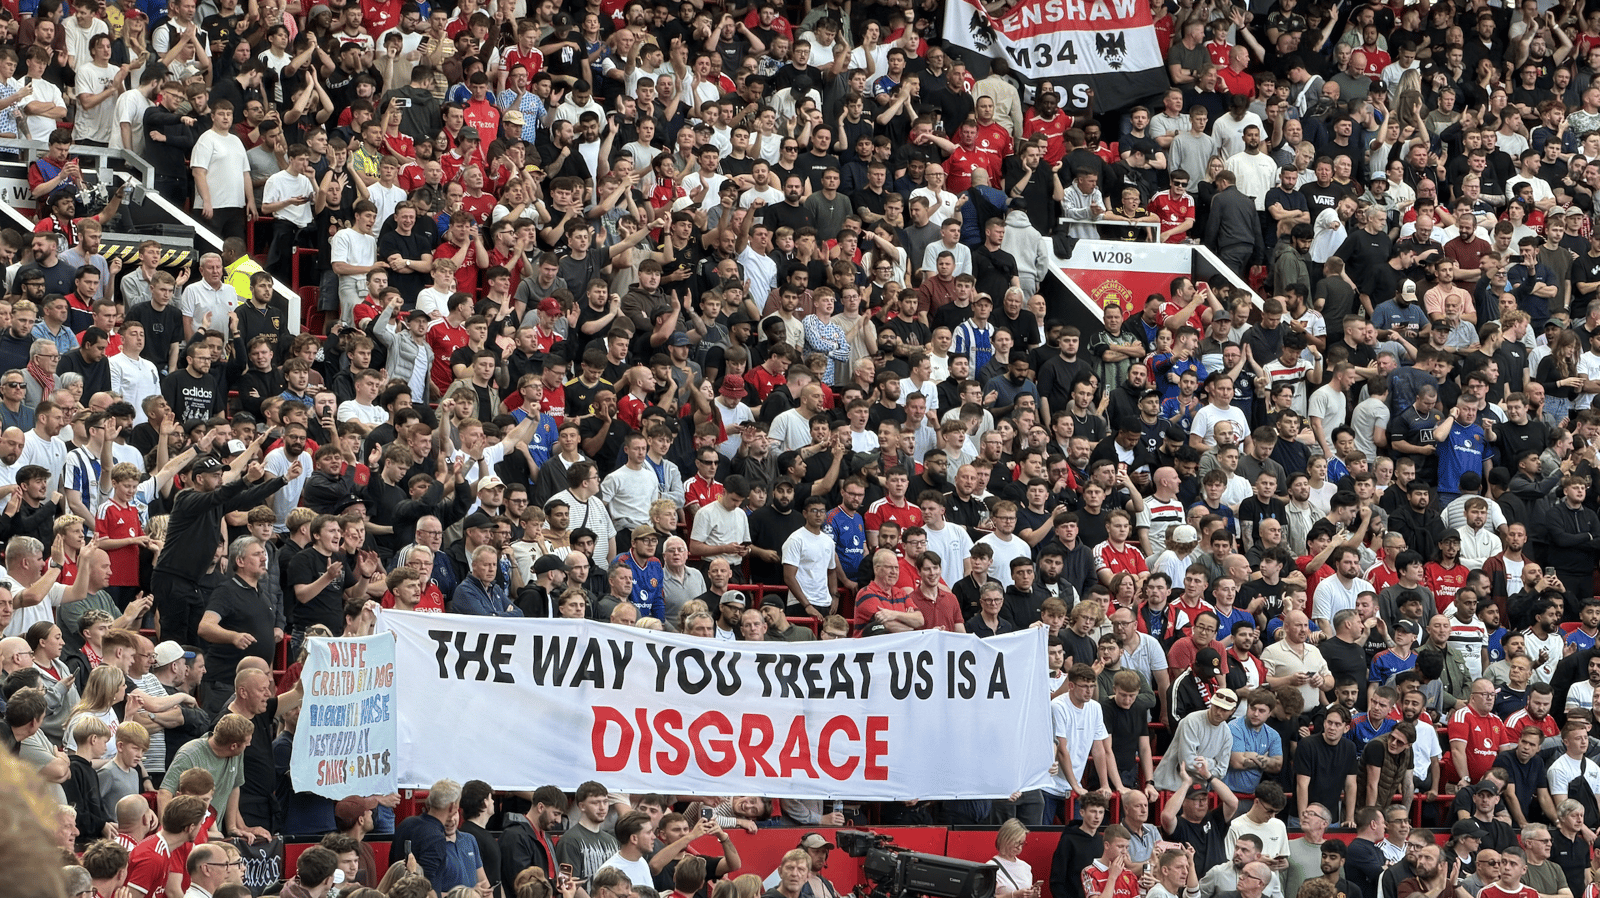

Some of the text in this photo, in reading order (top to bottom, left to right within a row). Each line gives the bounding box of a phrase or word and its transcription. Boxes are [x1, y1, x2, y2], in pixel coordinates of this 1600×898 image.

[1006, 40, 1078, 69] M34
[1313, 195, 1335, 206] VANS
[1092, 251, 1133, 265] W208
[1094, 282, 1130, 300] MANCHESTER
[182, 386, 213, 400] adidas
[327, 642, 367, 668] MUFC
[428, 630, 1011, 700] THE WAY YOU TREAT US IS A
[312, 670, 355, 696] CREATED
[309, 731, 357, 757] DESTROYED
[591, 705, 889, 781] DISGRACE
